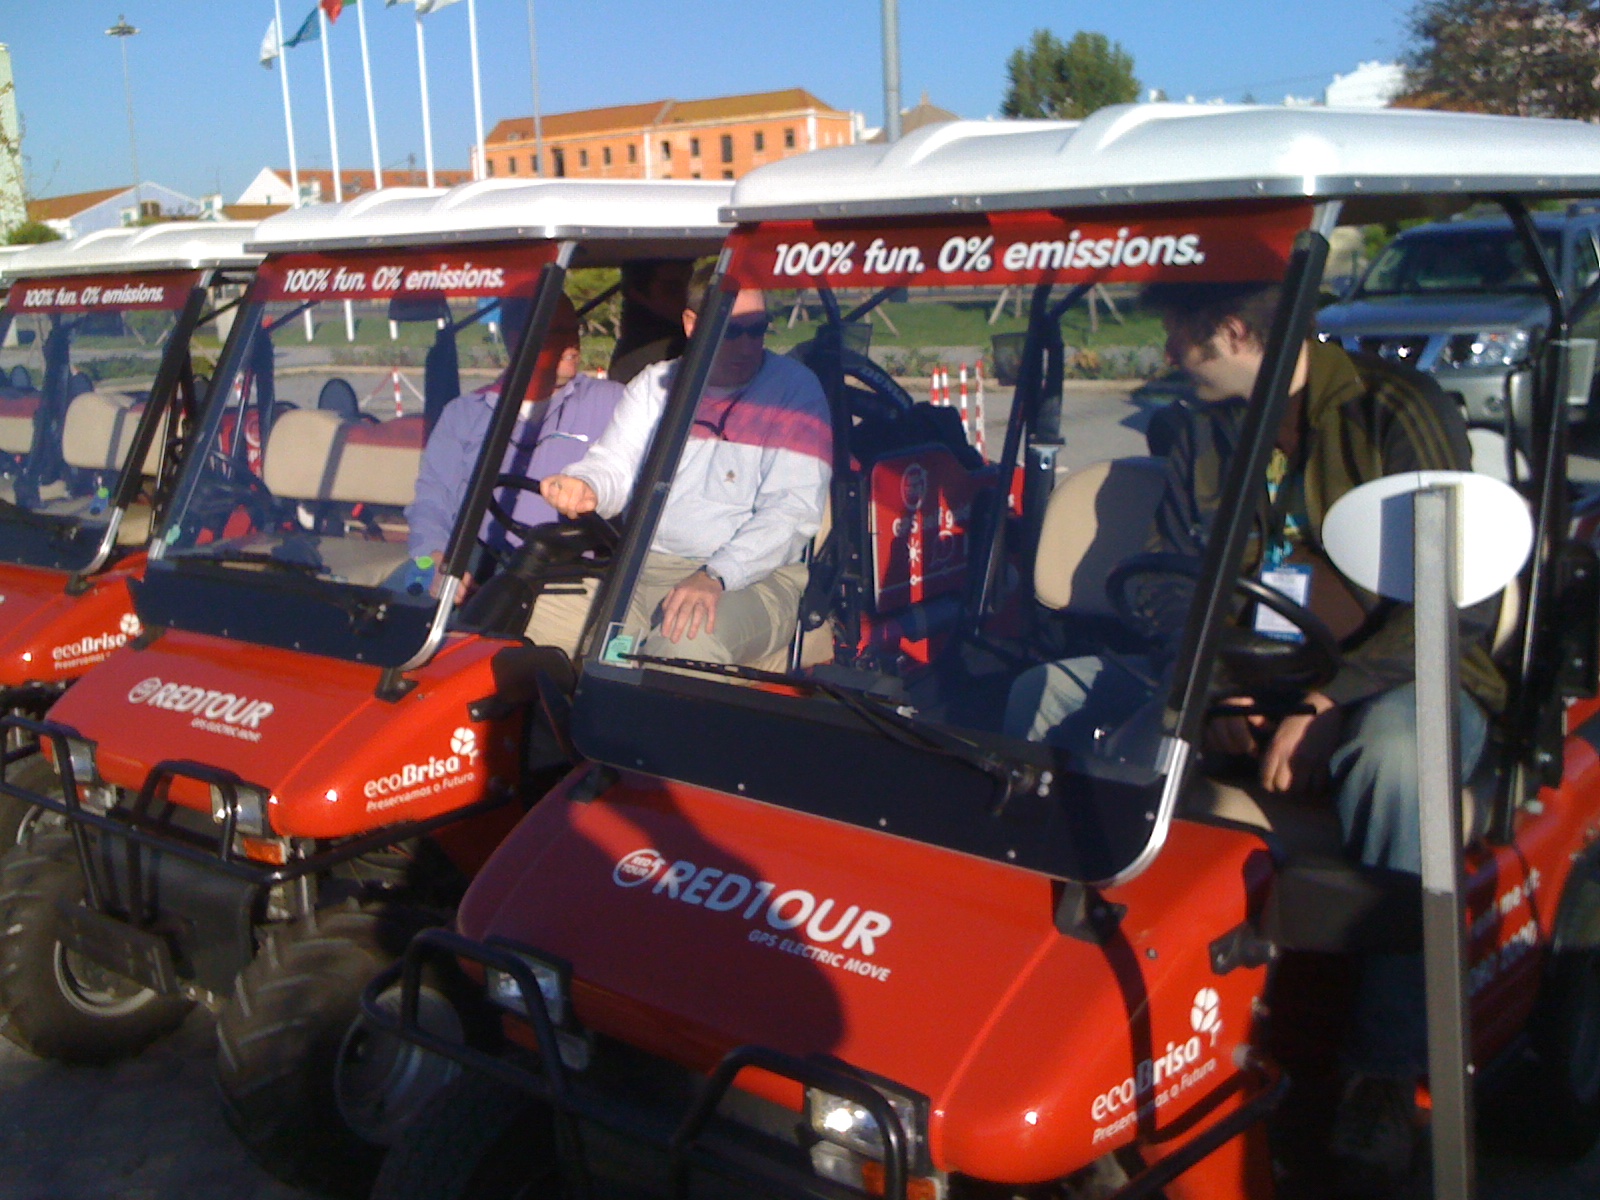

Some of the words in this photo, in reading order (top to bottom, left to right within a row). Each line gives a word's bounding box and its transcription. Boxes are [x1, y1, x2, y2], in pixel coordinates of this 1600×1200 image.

[773, 240, 857, 276] 100%
[862, 237, 926, 274] fun.
[937, 234, 995, 272] 0%
[1002, 227, 1206, 271] emissions.
[23, 287, 55, 307] 100%
[80, 286, 102, 305] 0%
[101, 283, 165, 304] emissions.
[283, 268, 332, 293] 100%
[332, 265, 367, 291] fun.
[371, 265, 404, 291] 0%
[405, 262, 505, 290] emissions.
[148, 682, 274, 729] REDTOUR
[364, 756, 460, 798] ecoBrisa
[749, 929, 778, 948] GPS
[778, 939, 845, 968] ELECTRIC
[843, 957, 891, 982] MOVE
[1091, 1036, 1200, 1121] ecoBrisa
